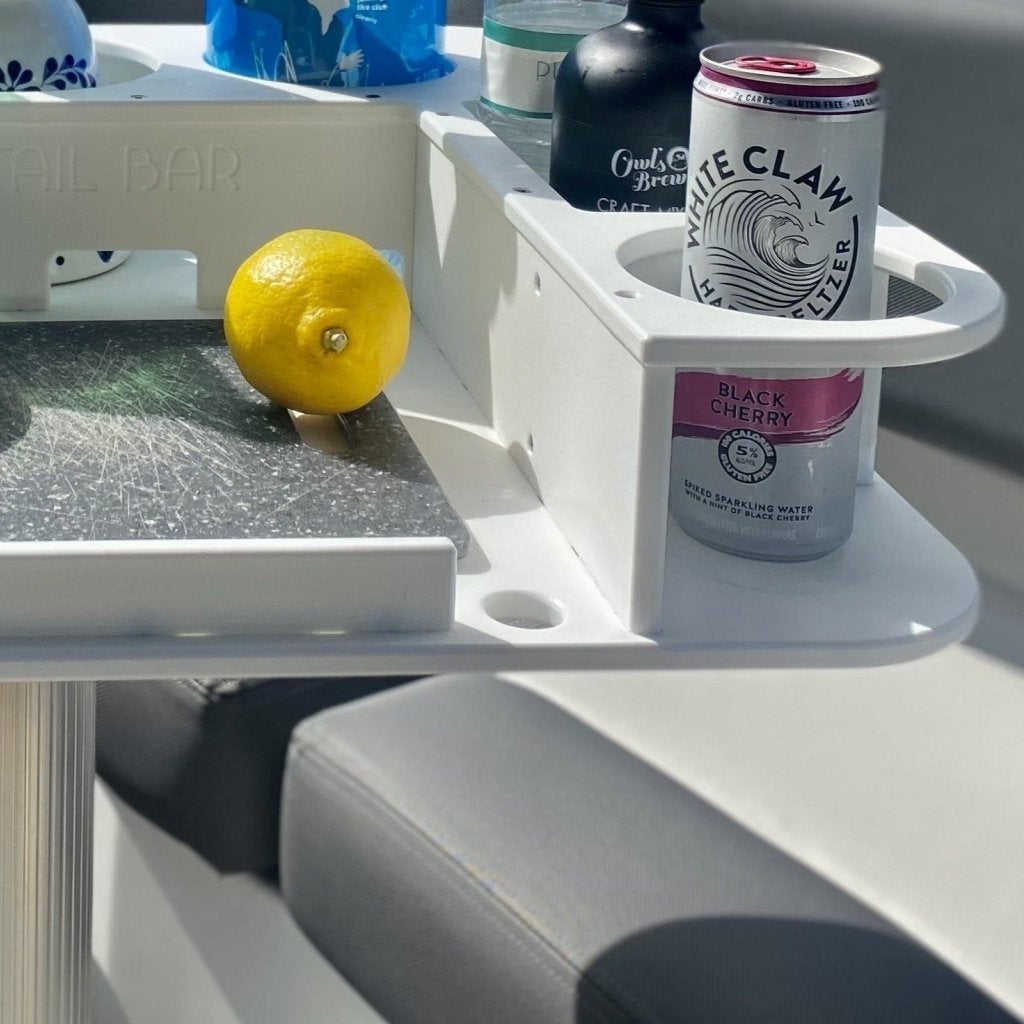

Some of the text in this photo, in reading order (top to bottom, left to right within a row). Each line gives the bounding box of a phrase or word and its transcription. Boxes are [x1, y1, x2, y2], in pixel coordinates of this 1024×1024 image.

[745, 92, 775, 106] CARBS
[122, 143, 241, 193] BAR
[611, 147, 667, 178] Owl's
[632, 171, 688, 192] Brew
[687, 145, 853, 249] WHITE CLAW
[778, 238, 851, 319] ELTZER
[719, 381, 786, 409] BLACK
[710, 398, 794, 427] CHERRY
[684, 479, 814, 514] SPIKED SPARKLING WATER
[685, 489, 701, 502] WITH
[709, 501, 729, 511] HINT
[730, 507, 742, 515] OF
[744, 510, 774, 521] BLACK
[776, 514, 811, 522] CHERRY
